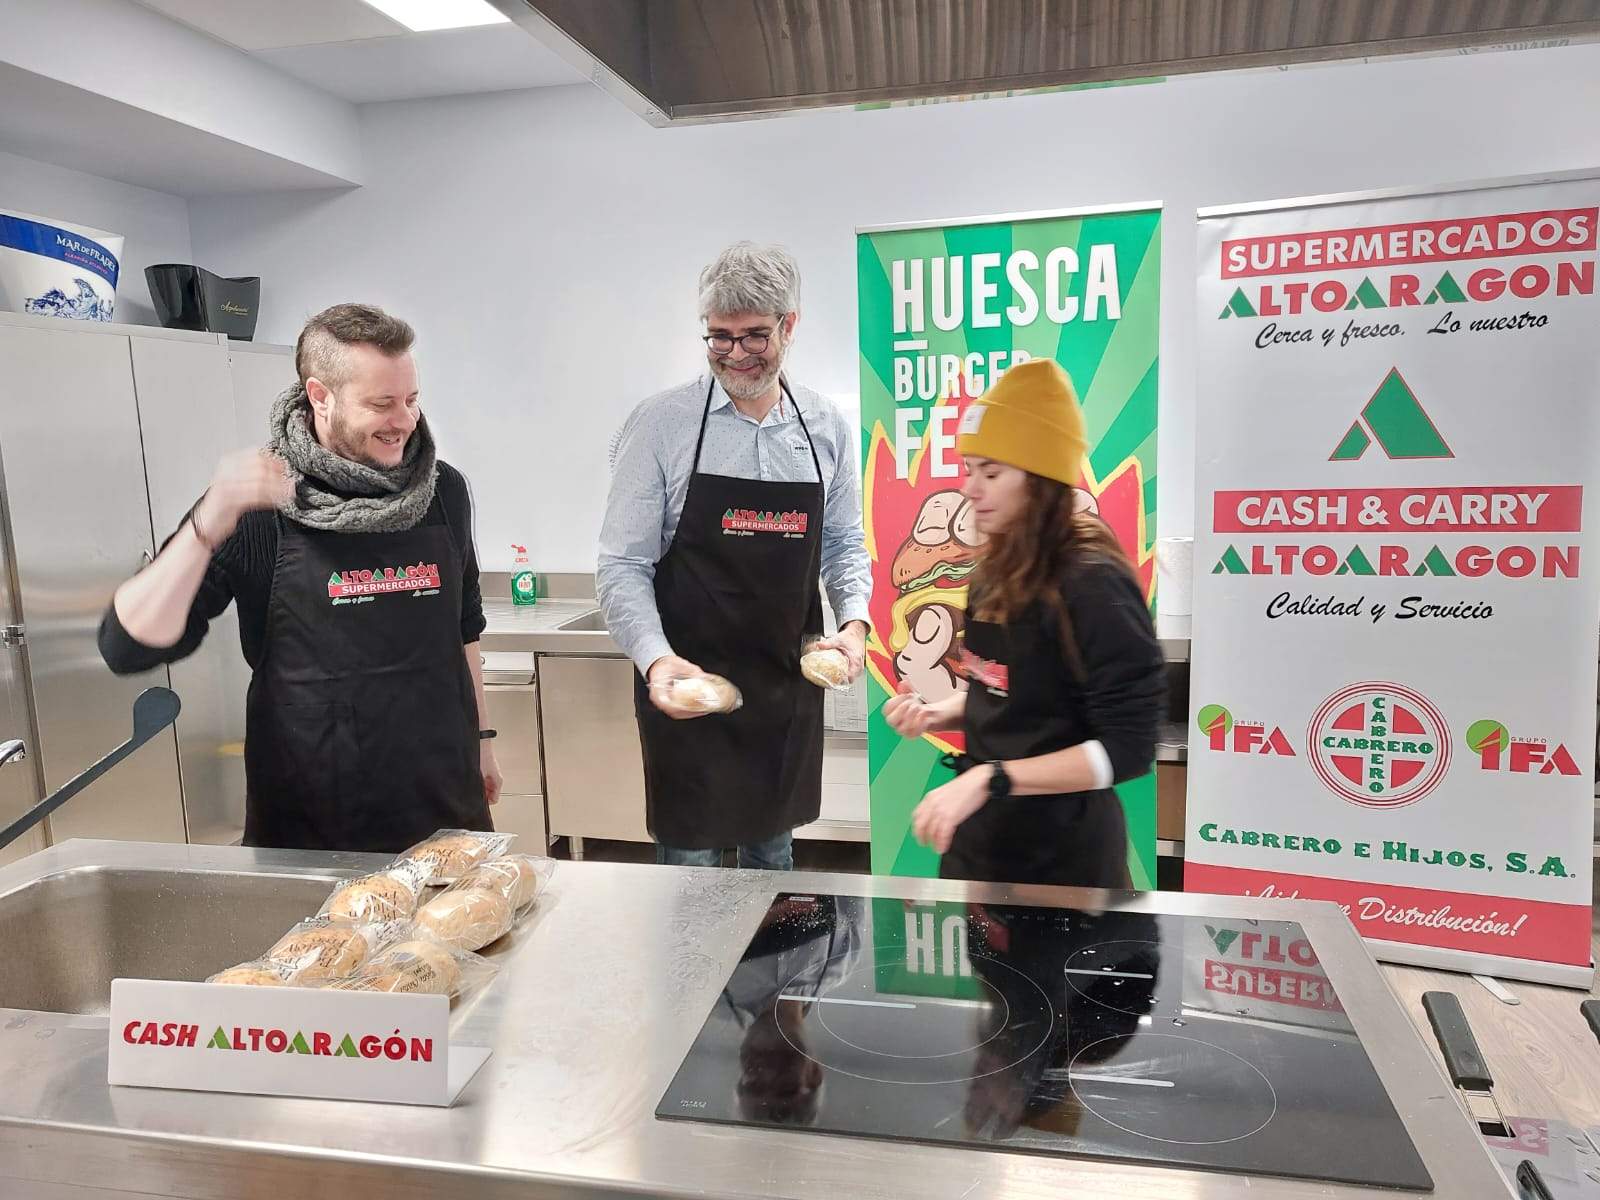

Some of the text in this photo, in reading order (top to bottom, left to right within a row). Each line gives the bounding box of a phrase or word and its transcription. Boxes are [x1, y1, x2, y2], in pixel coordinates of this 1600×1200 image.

[56, 234, 81, 252] MAR
[90, 248, 116, 272] FRADES
[1227, 215, 1590, 273] SUPERMERCADOS
[892, 244, 1121, 333] HUESCA
[1218, 261, 1595, 320] ALTOARAGON
[1255, 311, 1549, 349] Cerca y fresco. Lo nuestro
[731, 520, 799, 531] SUPERMERCADOS
[1237, 493, 1551, 526] CASH & CARRY
[328, 561, 439, 585] ALTOARAGÓN
[1211, 544, 1581, 578] ALTOARAGON
[342, 578, 431, 594] SUPERMERCADOS
[1266, 591, 1494, 624] Calidad y Servicio
[1323, 737, 1434, 754] CABRERO
[1199, 823, 1342, 854] CABRERO
[1505, 853, 1576, 879] S.A.
[1358, 897, 1529, 937] Distribución!
[123, 1021, 433, 1063] CASH ALTOARAGÓN
